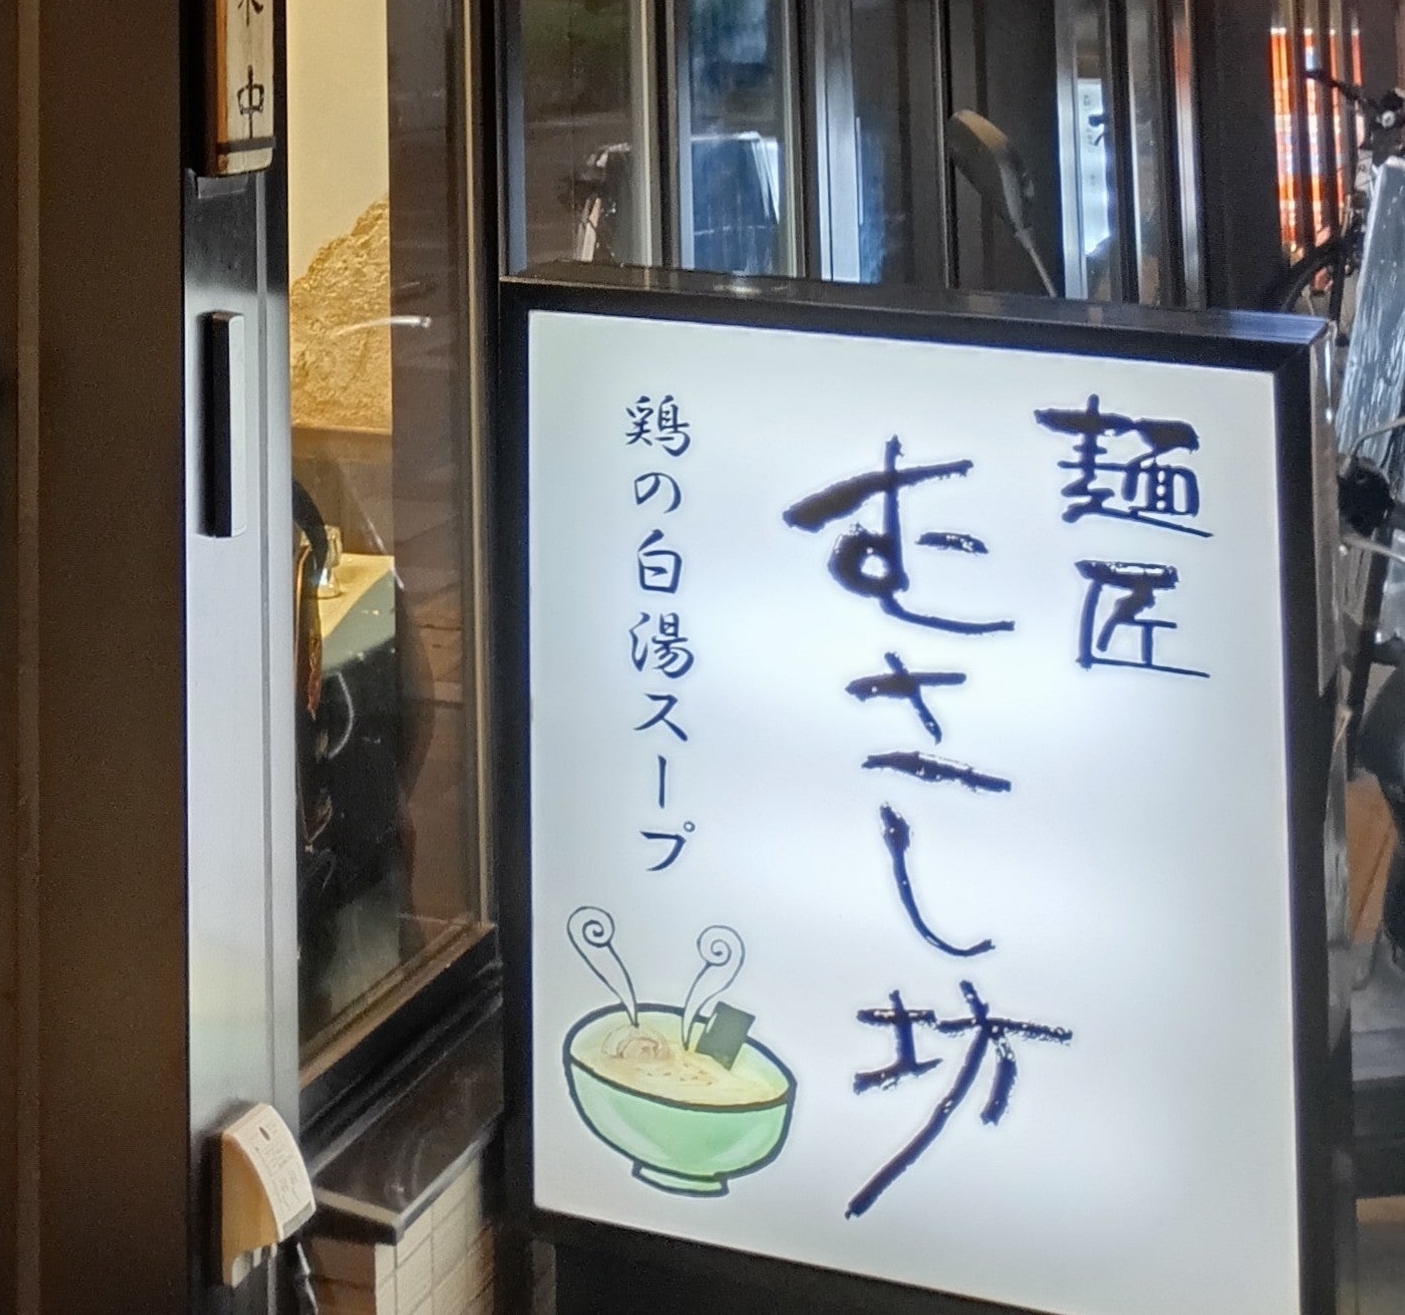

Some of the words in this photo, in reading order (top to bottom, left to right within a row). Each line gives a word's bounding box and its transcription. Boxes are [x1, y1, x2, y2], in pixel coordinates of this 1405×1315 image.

[624, 394, 696, 874] 鶏の白湯スープ
[1032, 393, 1215, 680] 麺匠
[781, 433, 1074, 1220] むさし坊
